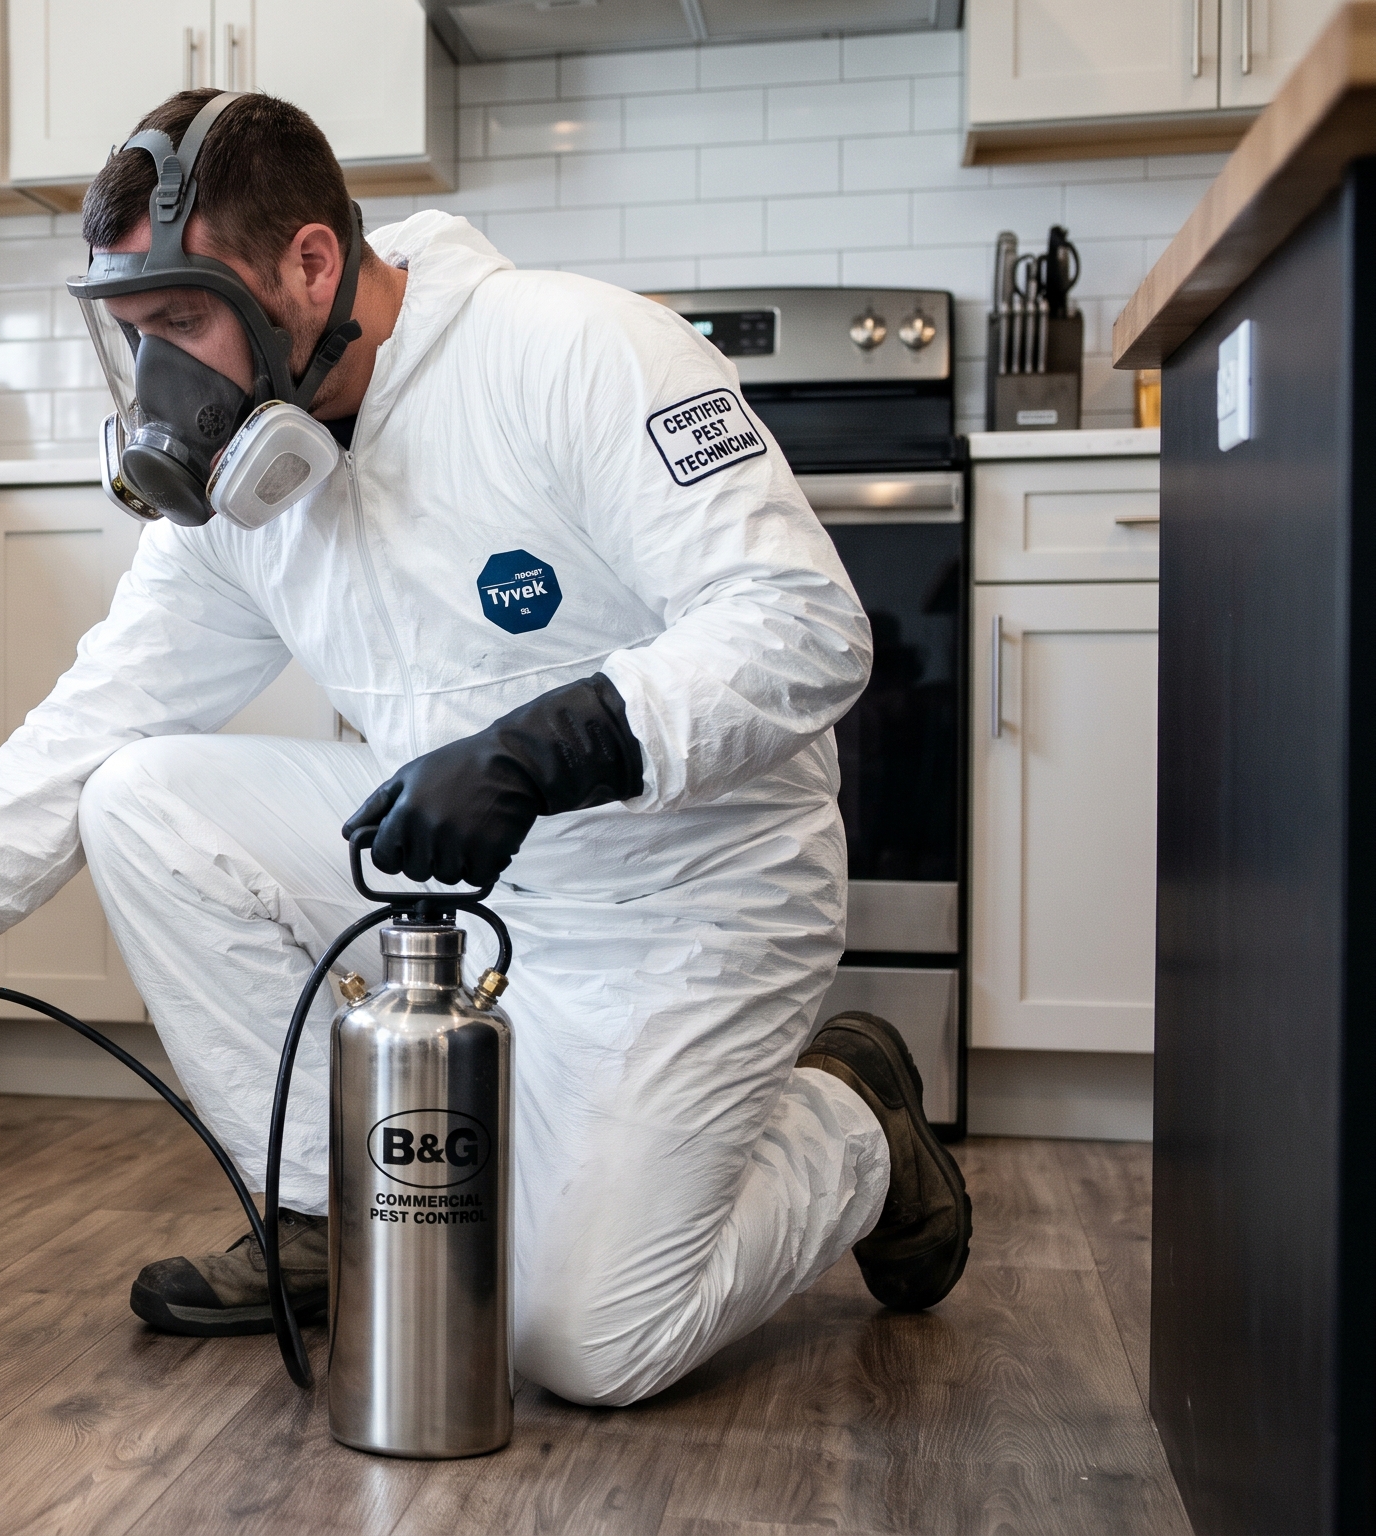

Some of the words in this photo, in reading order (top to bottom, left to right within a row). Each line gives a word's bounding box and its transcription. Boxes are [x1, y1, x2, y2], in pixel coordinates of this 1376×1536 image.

[663, 397, 731, 434] CERTIFIED
[691, 419, 729, 445] PEST
[674, 431, 759, 475] TECHNICIAN
[487, 580, 548, 608] Tyvek
[383, 1127, 479, 1167] B&G
[375, 1193, 483, 1207] COMMERCIAL
[370, 1208, 409, 1223] PEST
[413, 1209, 487, 1224] CONTROL
